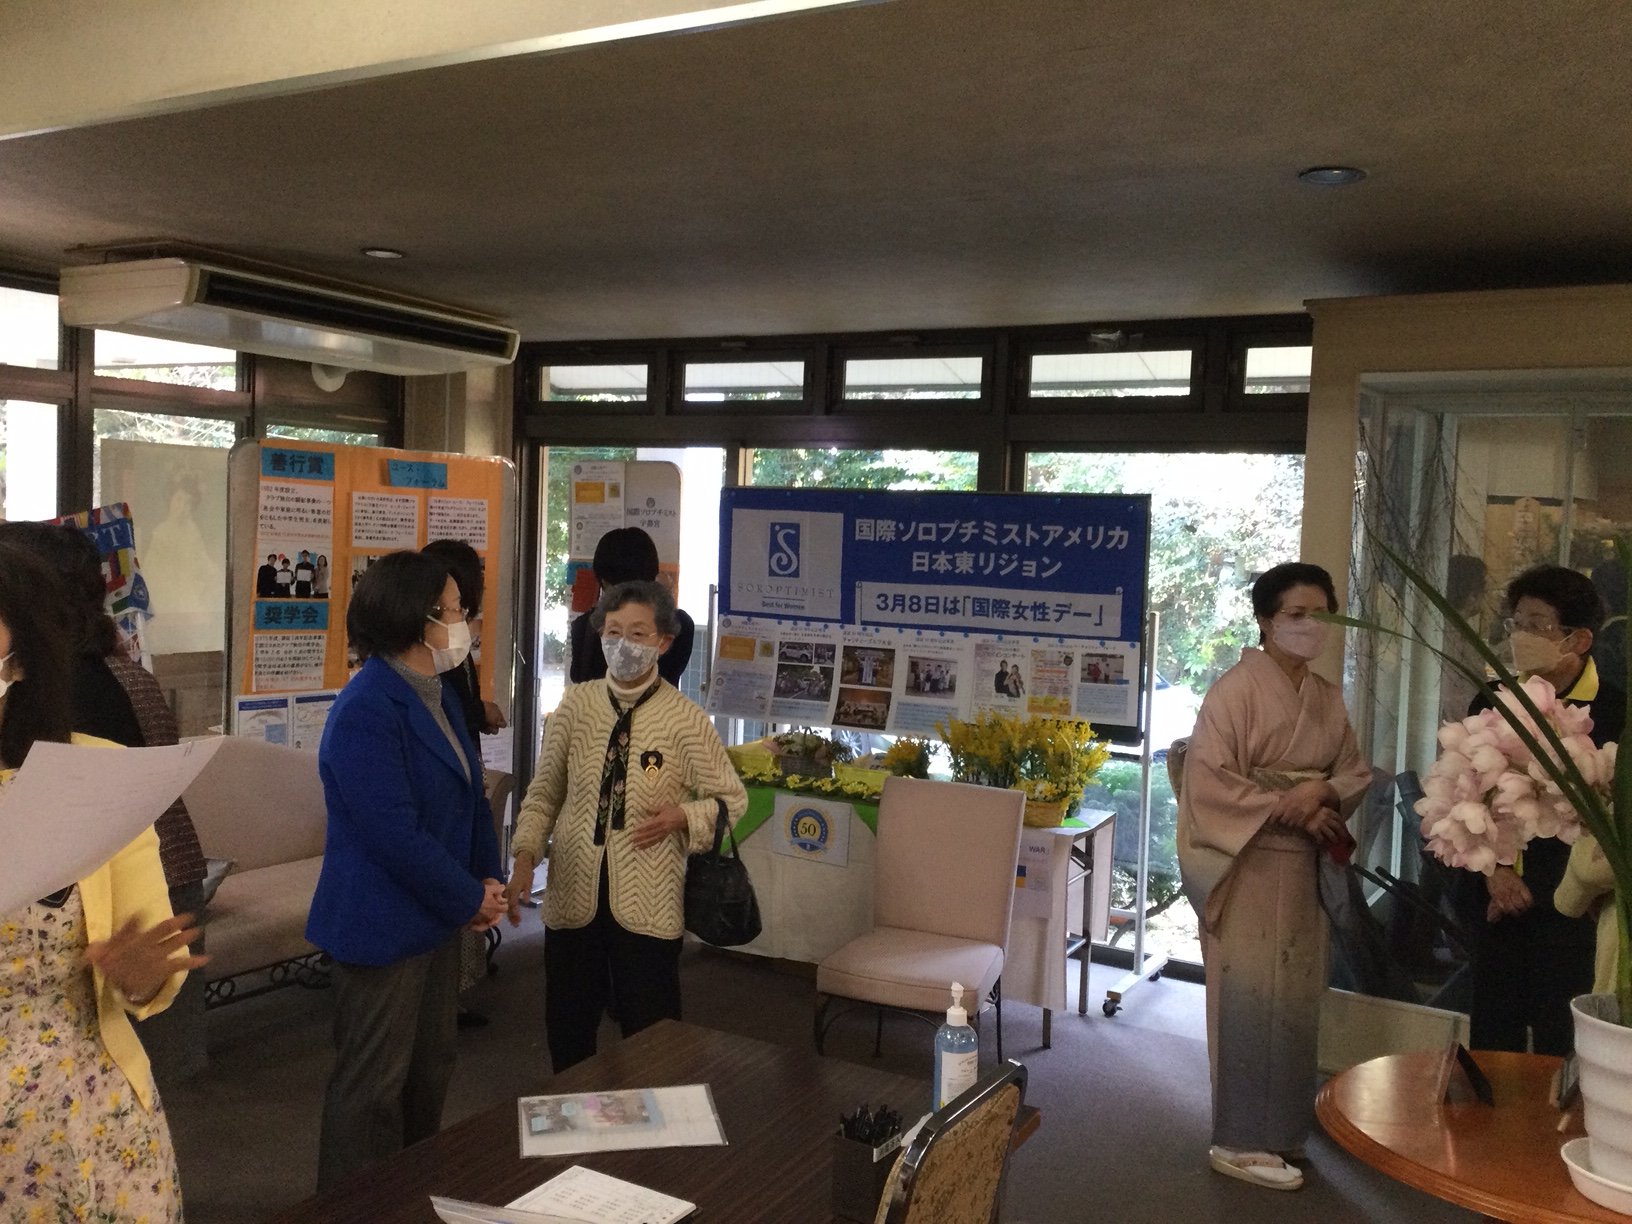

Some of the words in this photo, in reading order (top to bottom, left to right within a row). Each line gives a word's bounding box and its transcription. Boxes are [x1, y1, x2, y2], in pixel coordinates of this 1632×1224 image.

[854, 518, 1129, 550] 国際ソロプチミストアメリカ
[911, 550, 1063, 578] 日本東リジョン
[737, 582, 835, 598] SOROPTIMIST
[263, 605, 319, 625] 奨学会
[875, 592, 1104, 627] 3月8日は「国際女性デー」
[800, 822, 817, 837] 50
[1028, 845, 1046, 854] WAR
